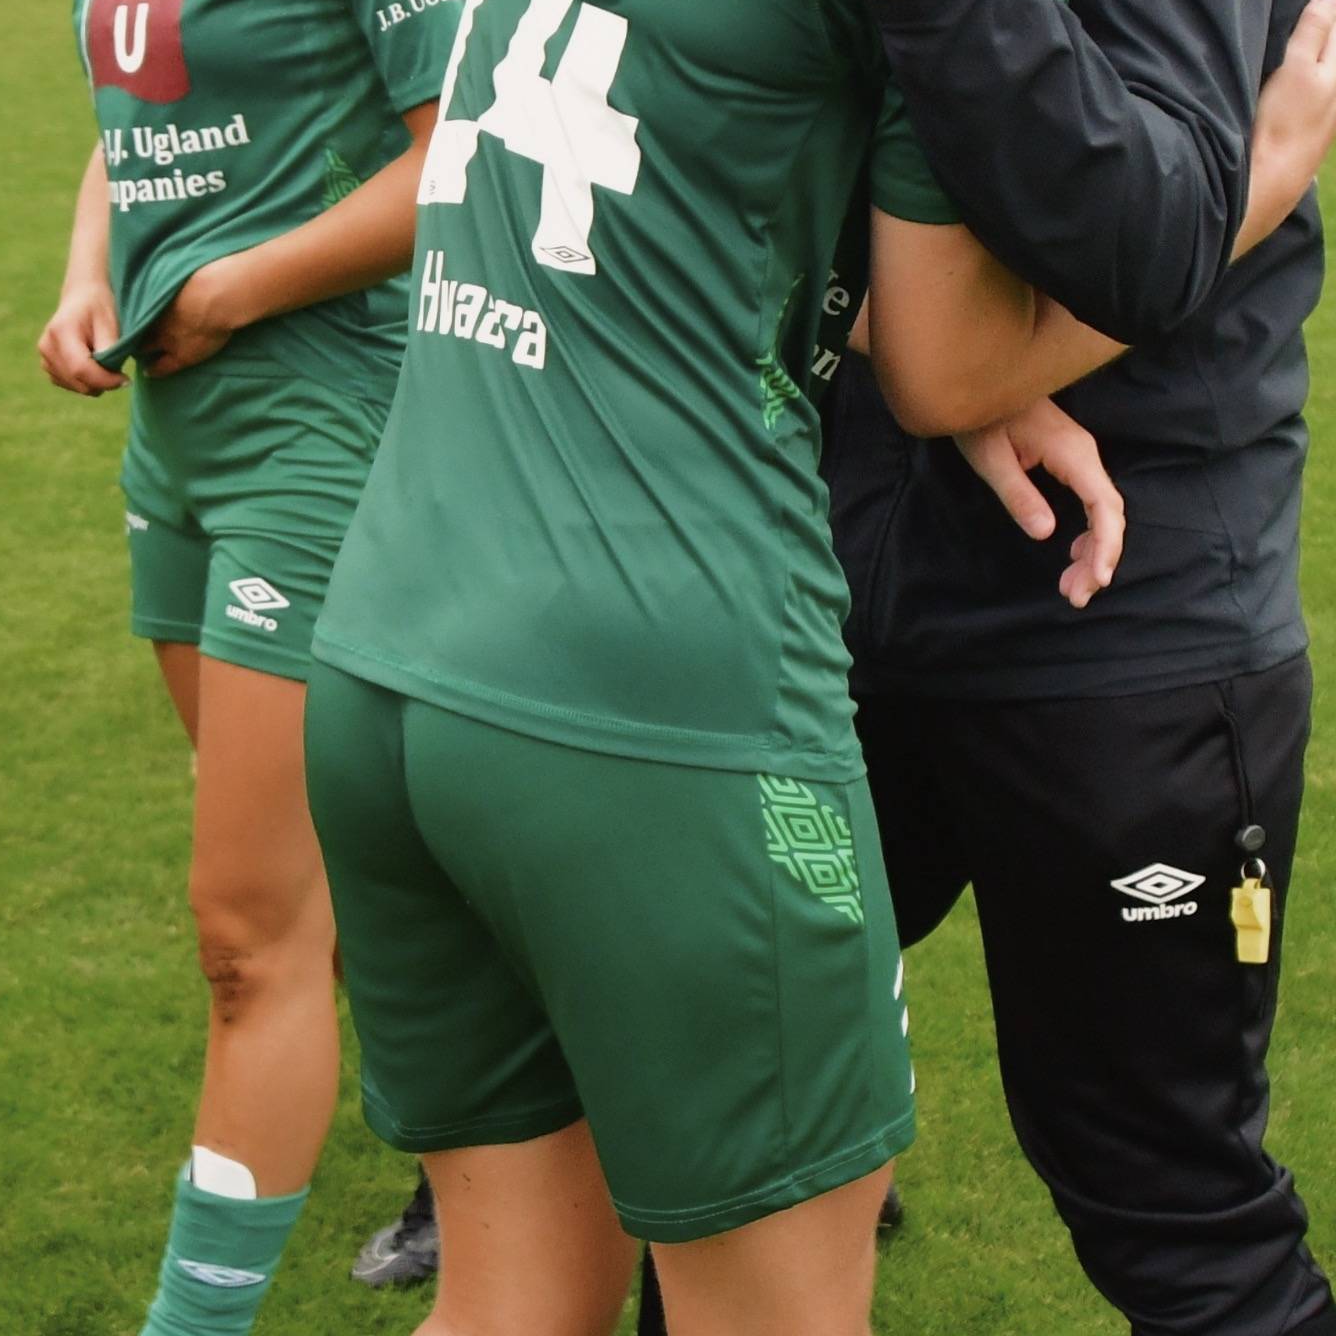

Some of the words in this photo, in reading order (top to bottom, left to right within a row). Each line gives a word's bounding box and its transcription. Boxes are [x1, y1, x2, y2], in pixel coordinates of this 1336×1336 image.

[376, 2, 411, 32] J.B.
[114, 3, 149, 74] U
[132, 113, 251, 165] Ugland
[109, 168, 226, 212] mpanies
[225, 604, 278, 631] umbro
[1122, 901, 1198, 922] umbro
